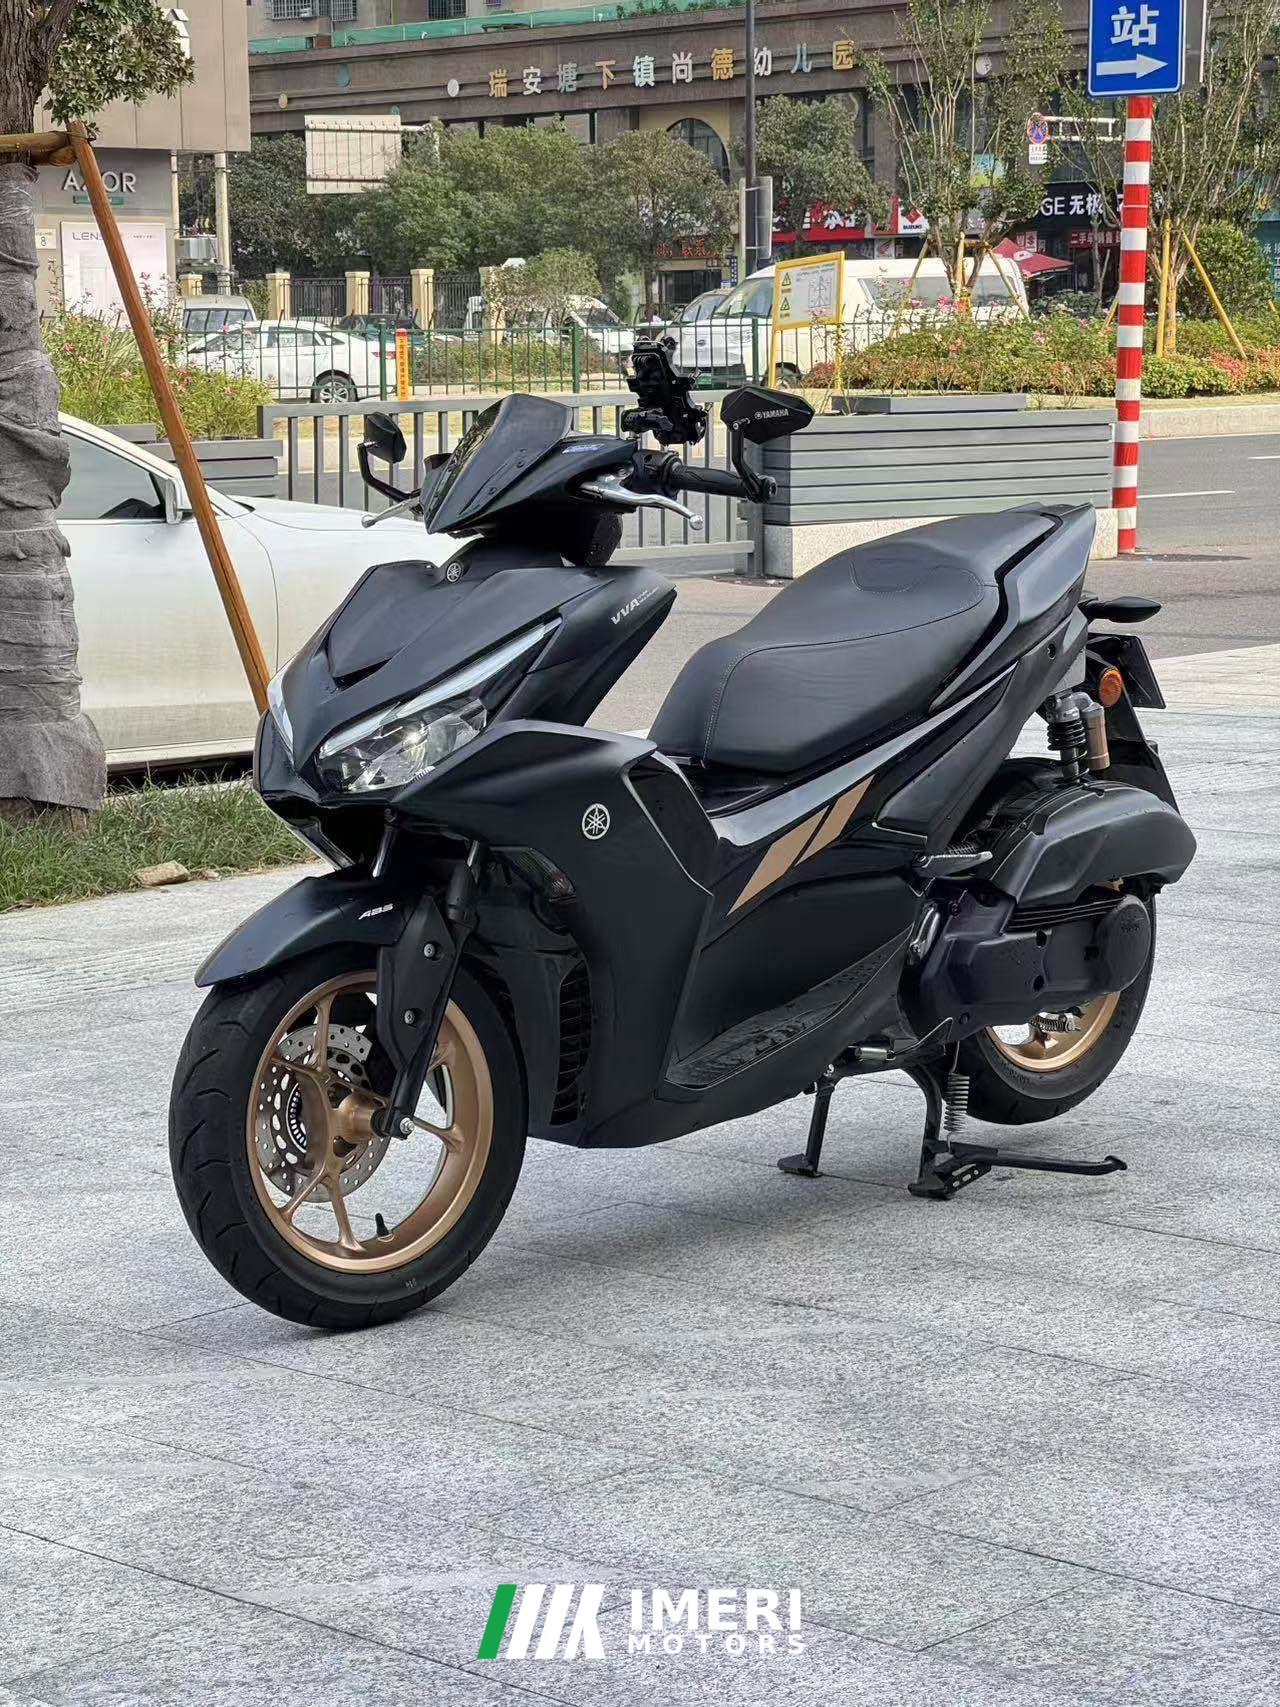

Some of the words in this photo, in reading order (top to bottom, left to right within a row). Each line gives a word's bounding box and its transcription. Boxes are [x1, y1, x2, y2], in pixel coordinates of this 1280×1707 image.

[1110, 4, 1159, 46] 站
[489, 40, 855, 98] 瑞安塘下镇尚德幼儿园
[63, 169, 136, 193] AOR
[762, 408, 789, 419] YAMAHA
[610, 598, 640, 625] VVA
[358, 903, 394, 920] ABS
